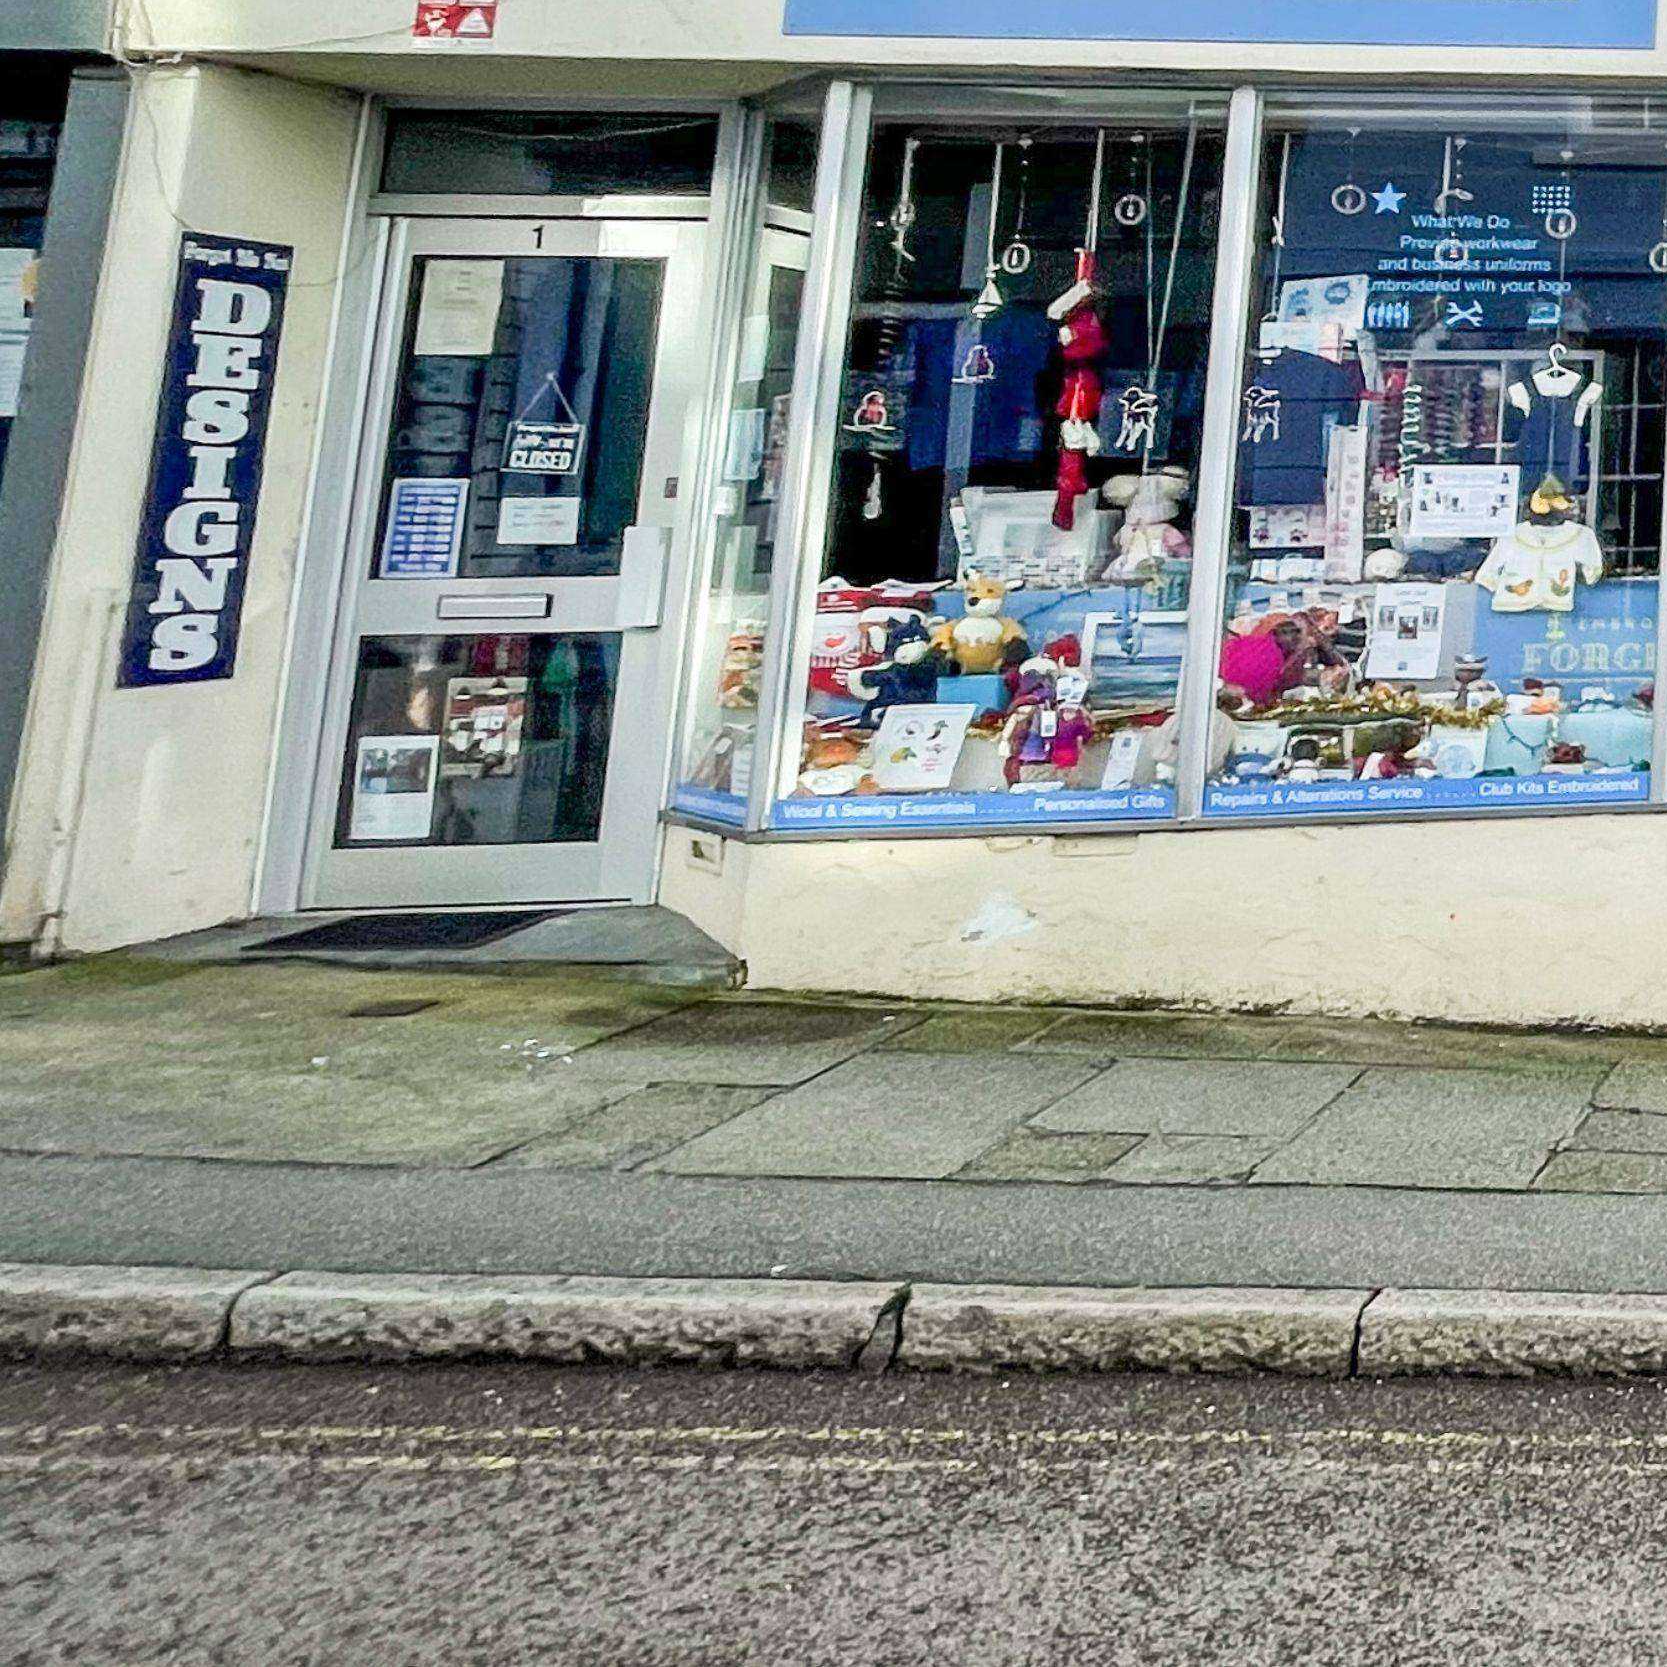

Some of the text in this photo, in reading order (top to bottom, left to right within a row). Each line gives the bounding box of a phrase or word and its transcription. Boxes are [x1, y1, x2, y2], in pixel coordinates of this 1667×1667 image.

[1410, 214, 1511, 229] What We Do
[532, 224, 545, 249] 1
[1461, 235, 1538, 250] workwear
[1377, 257, 1408, 271] and
[1485, 258, 1552, 272] uniforms
[1368, 278, 1572, 296] mbroidered with your logo
[509, 449, 572, 470] CLOSED
[148, 277, 272, 672] DESIGNS
[1272, 790, 1283, 805] &
[1285, 787, 1364, 804] Alterations
[1367, 785, 1424, 801] Service
[1478, 780, 1514, 797] Club
[825, 803, 838, 818] &
